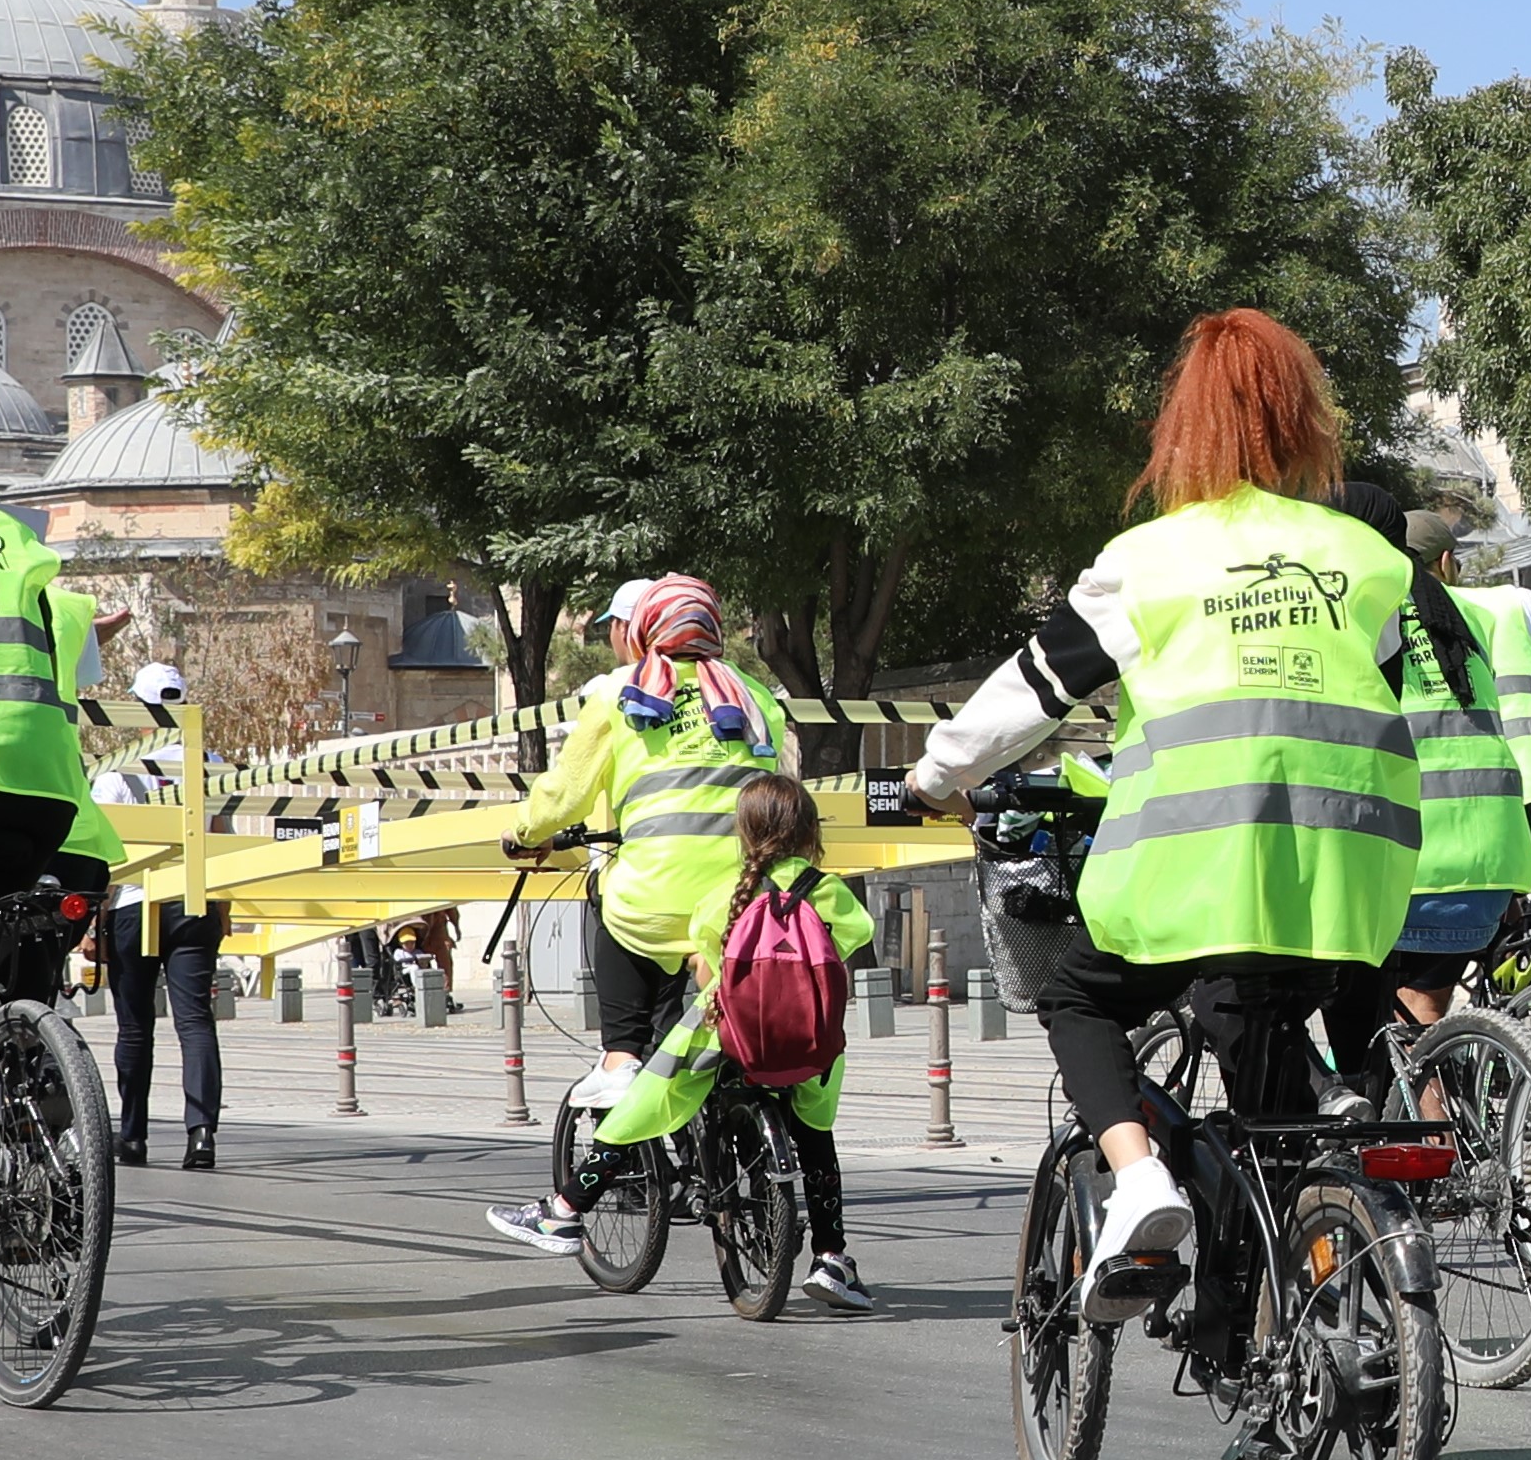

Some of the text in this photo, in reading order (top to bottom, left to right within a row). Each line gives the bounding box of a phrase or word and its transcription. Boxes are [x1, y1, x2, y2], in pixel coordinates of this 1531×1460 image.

[1203, 586, 1313, 617] Bisikletliyi
[1231, 606, 1318, 635] FARK ET!
[669, 718, 700, 737] FARK
